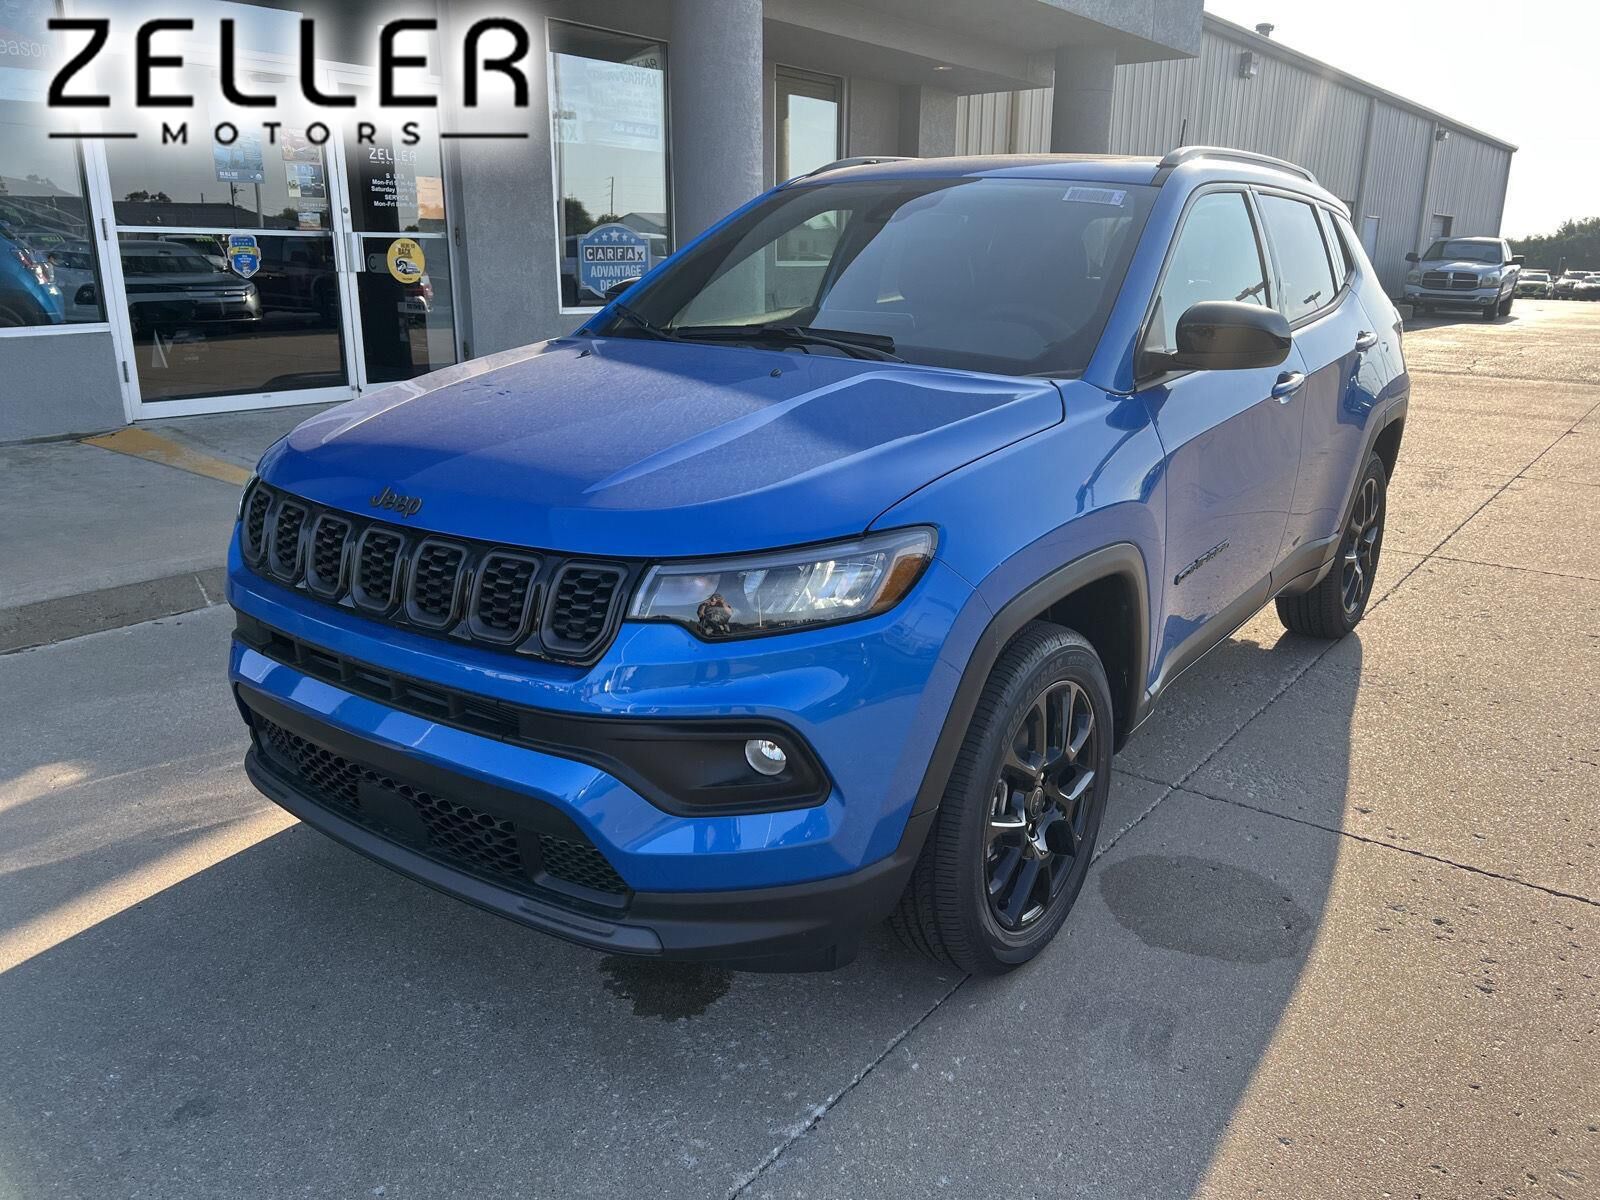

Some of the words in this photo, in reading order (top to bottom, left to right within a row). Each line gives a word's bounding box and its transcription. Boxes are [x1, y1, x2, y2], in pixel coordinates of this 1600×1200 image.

[368, 147, 417, 161] ZELLER
[586, 247, 644, 262] CARFAX
[590, 264, 642, 278] ADVANTAGE
[370, 486, 423, 518] Jeep
